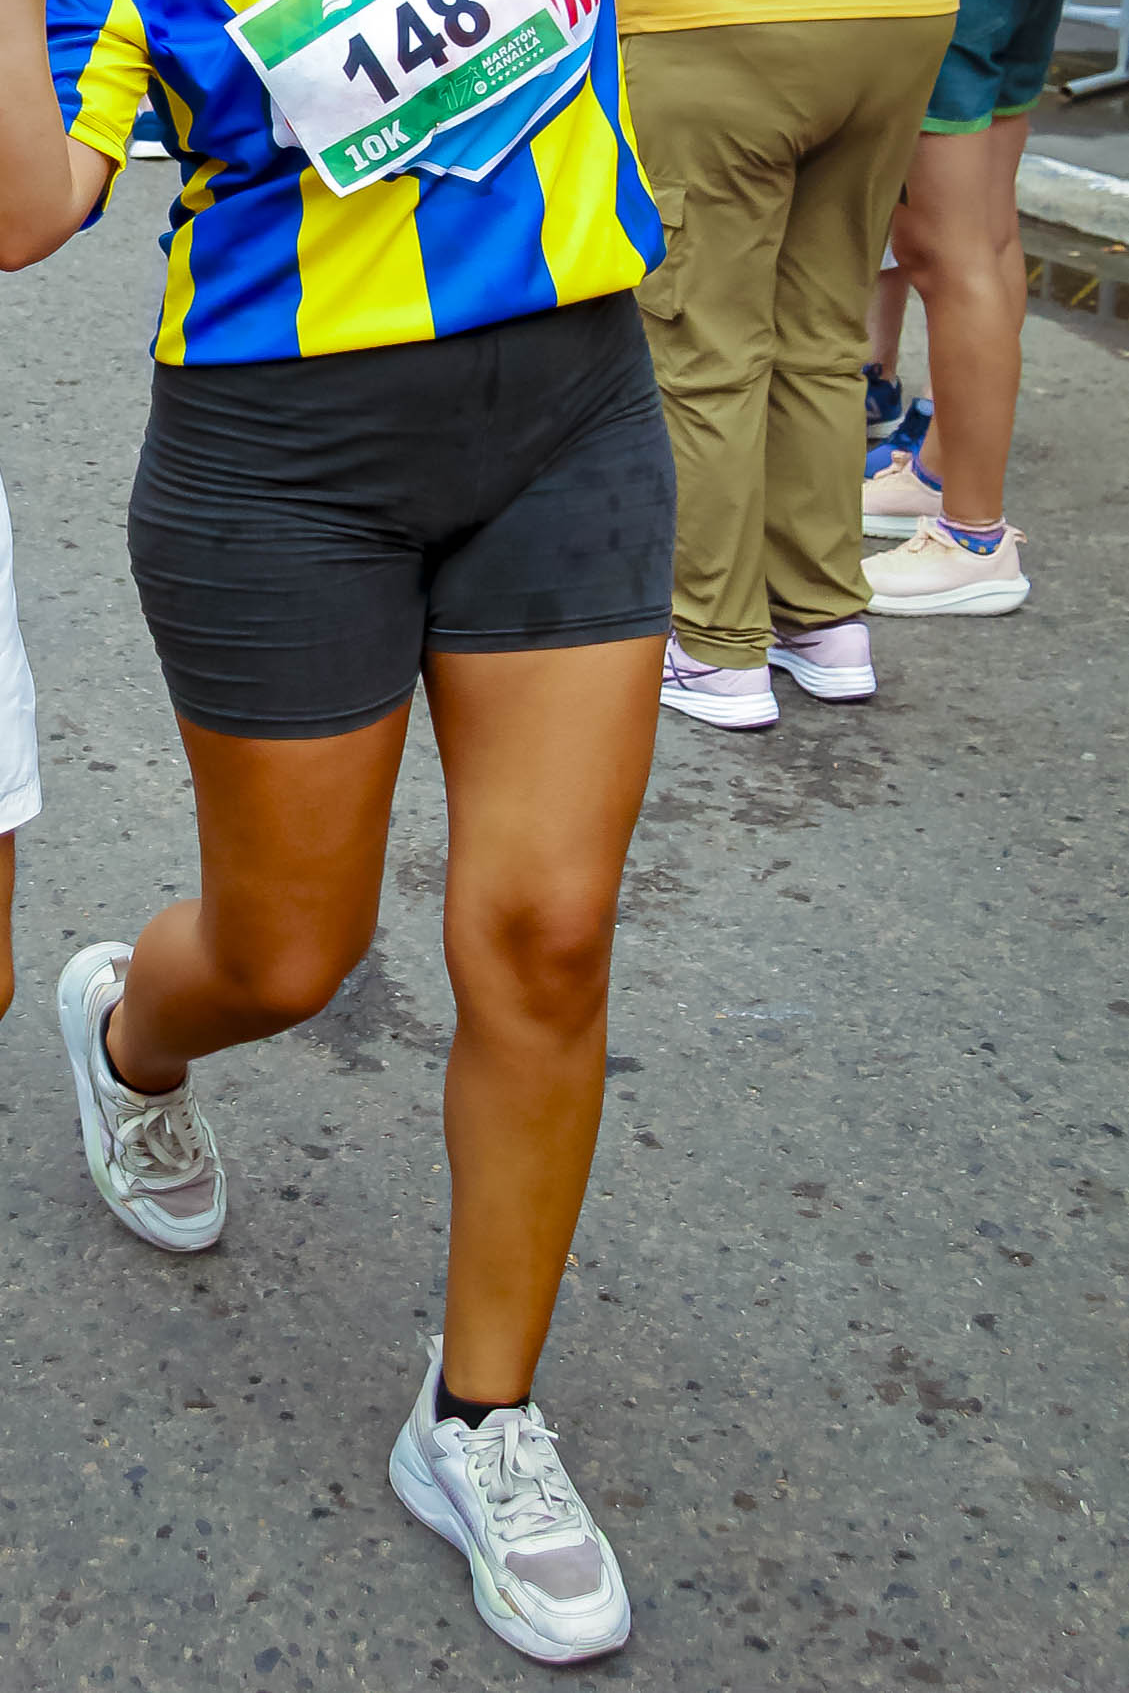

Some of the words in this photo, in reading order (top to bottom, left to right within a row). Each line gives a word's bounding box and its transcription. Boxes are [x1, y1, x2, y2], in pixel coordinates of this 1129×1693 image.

[481, 26, 537, 69] MARATÓN
[487, 38, 541, 76] CANALLA
[344, 119, 411, 172] 10K
